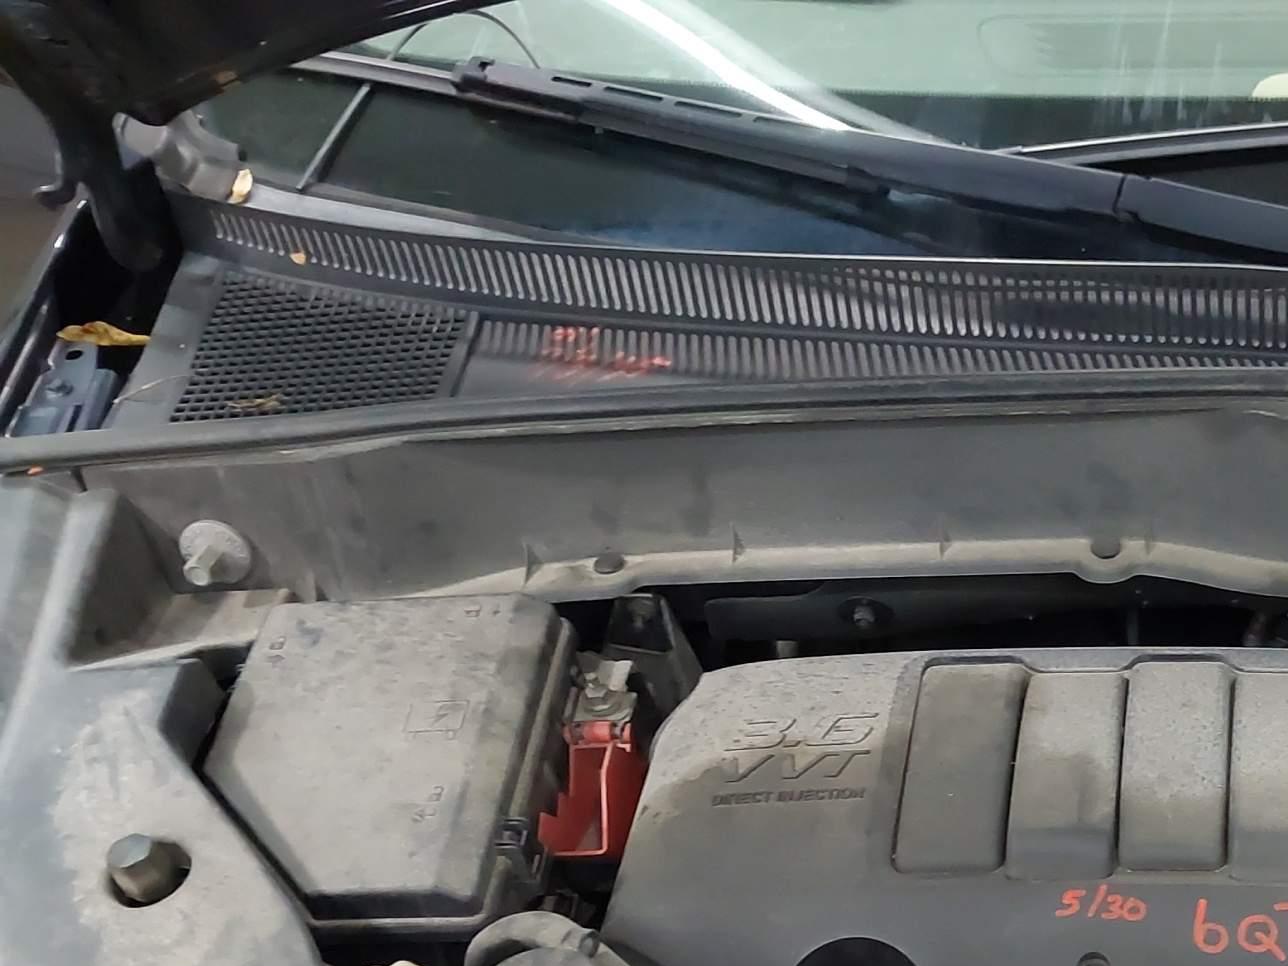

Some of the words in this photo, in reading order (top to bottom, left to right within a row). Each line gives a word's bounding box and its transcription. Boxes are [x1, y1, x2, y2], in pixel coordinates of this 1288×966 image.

[724, 711, 880, 752] 3.6
[719, 750, 872, 784] VVT
[712, 791, 776, 806] DIRECT
[777, 787, 867, 803] INJECTION
[1055, 884, 1148, 921] 5/30
